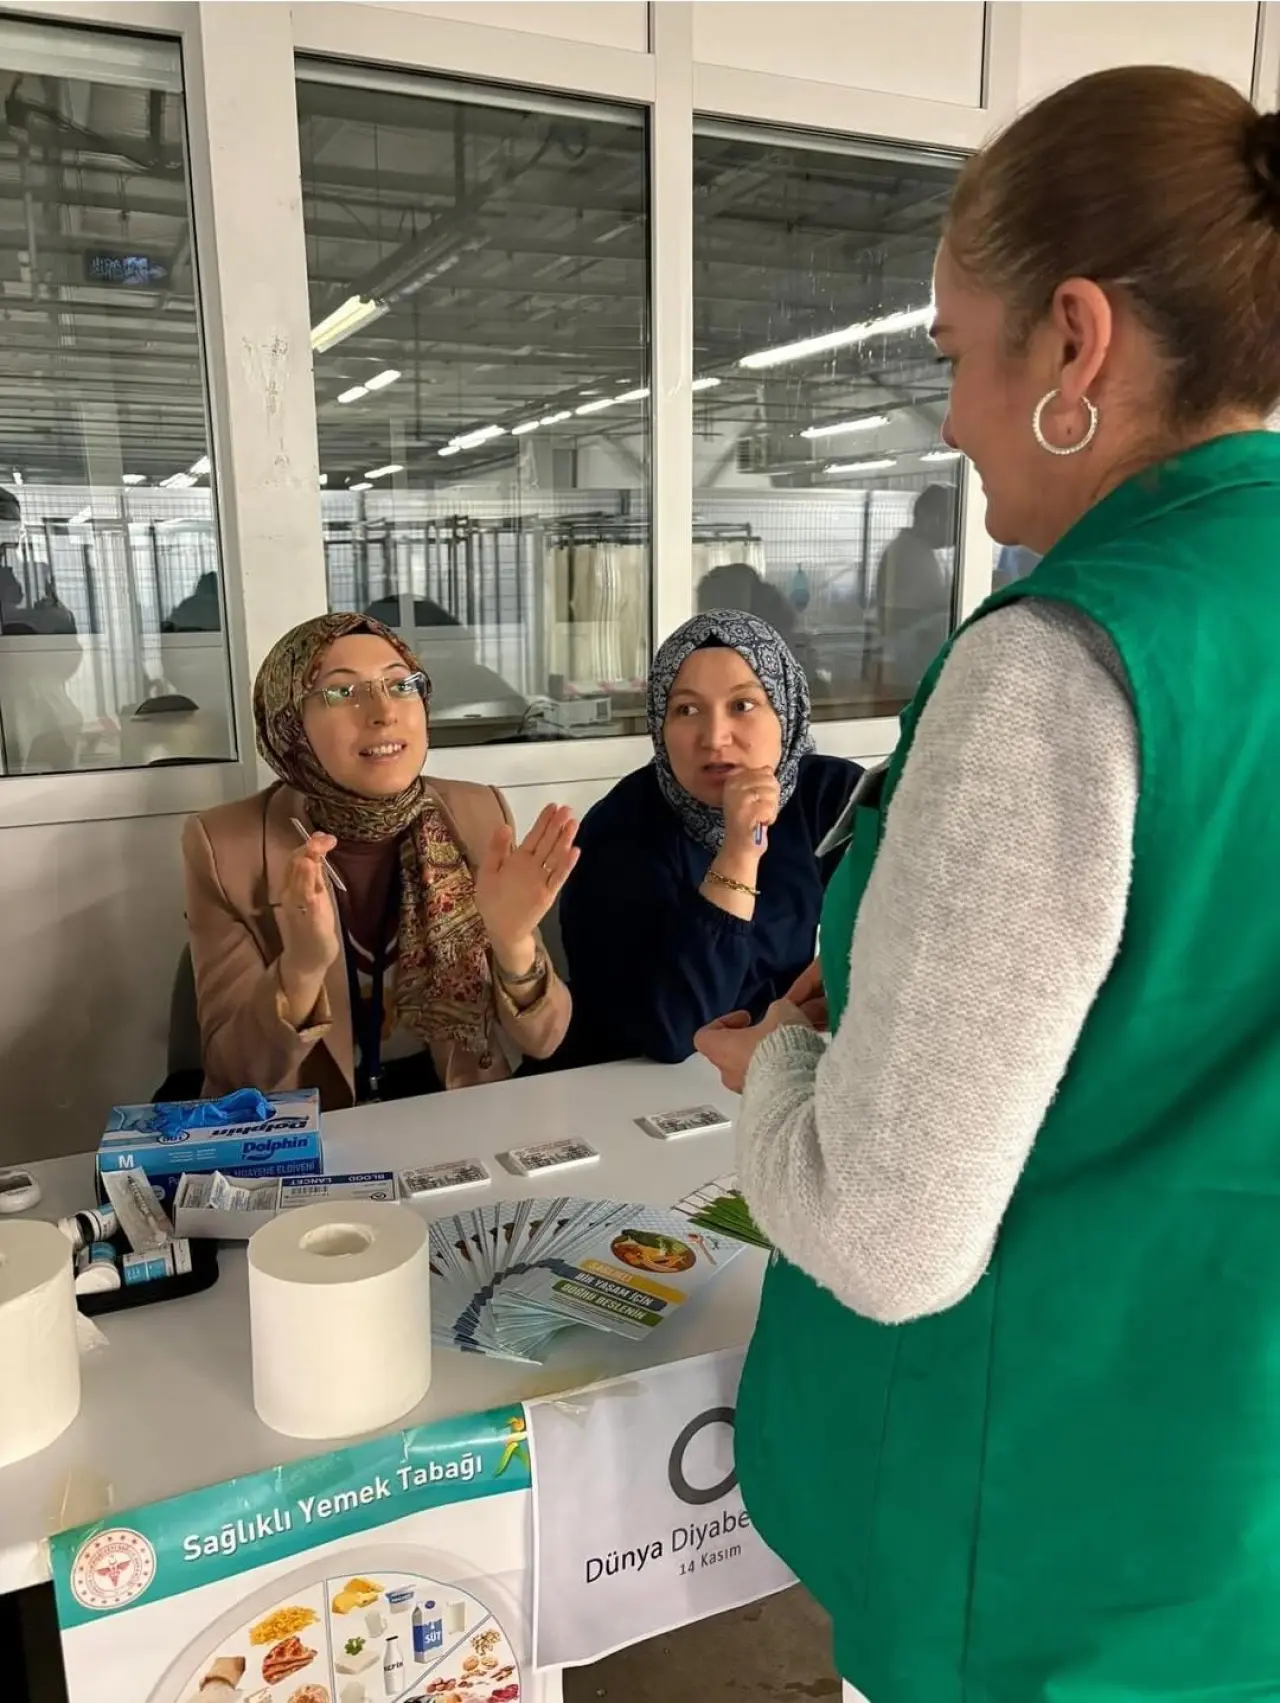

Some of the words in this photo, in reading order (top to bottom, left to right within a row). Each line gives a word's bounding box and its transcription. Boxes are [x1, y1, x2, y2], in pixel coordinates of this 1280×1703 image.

[242, 1136, 309, 1160] Dolphin
[118, 1153, 135, 1169] M
[290, 1177, 332, 1186] LANCET
[347, 1173, 385, 1182] BLOOD
[182, 1508, 292, 1562] Sağlıklı
[298, 1476, 392, 1524] Yemek
[396, 1452, 484, 1491] Tabağı
[586, 1541, 664, 1584] Dünya
[671, 1510, 751, 1553] Diyabe
[678, 1559, 696, 1576] 14
[700, 1544, 742, 1569] Kasım
